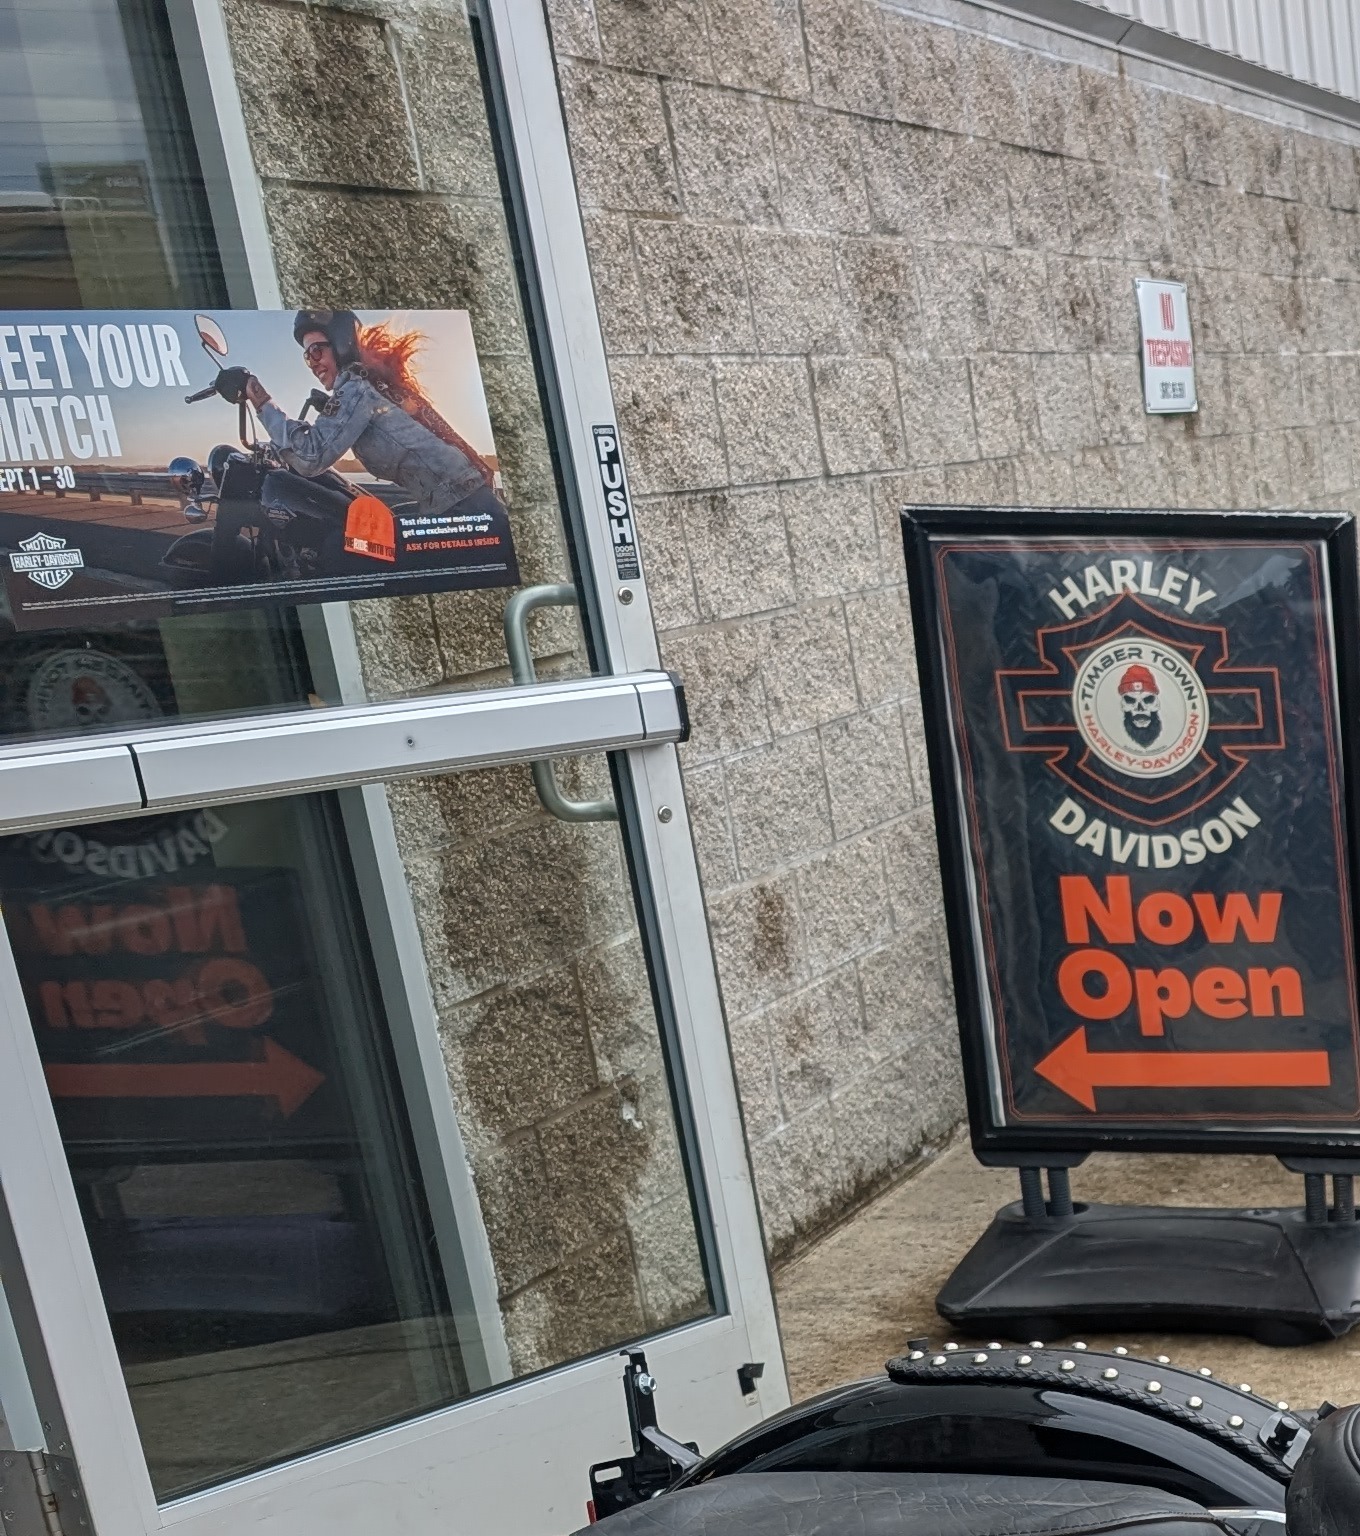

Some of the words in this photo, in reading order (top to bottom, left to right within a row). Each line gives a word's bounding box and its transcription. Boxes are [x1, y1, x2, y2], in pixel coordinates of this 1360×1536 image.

[0, 324, 73, 391] EET
[71, 323, 190, 389] YOUR
[28, 466, 40, 490] 1
[53, 465, 76, 489] 30
[597, 435, 633, 544] PUSH
[25, 536, 62, 551] MOTOR
[400, 518, 416, 526] Test
[417, 516, 431, 525] ride
[402, 529, 415, 538] get
[426, 525, 458, 535] exclusive
[406, 543, 422, 551] ASK
[423, 541, 440, 550] FOR
[441, 539, 473, 549] DETAILS
[474, 537, 500, 546] INSIDE
[13, 552, 80, 568] HARLEY-DAVIDSON
[33, 569, 68, 586] CYCLES
[1049, 559, 1217, 620] HARLEY
[1082, 647, 1144, 701] TIMBER
[1151, 650, 1198, 701] TOWN
[1084, 712, 1199, 769] HARLEY-DAVIDSON
[1050, 797, 1262, 868] DAVIDSON
[1060, 875, 1283, 945] Now
[1058, 948, 1304, 1036] Open
